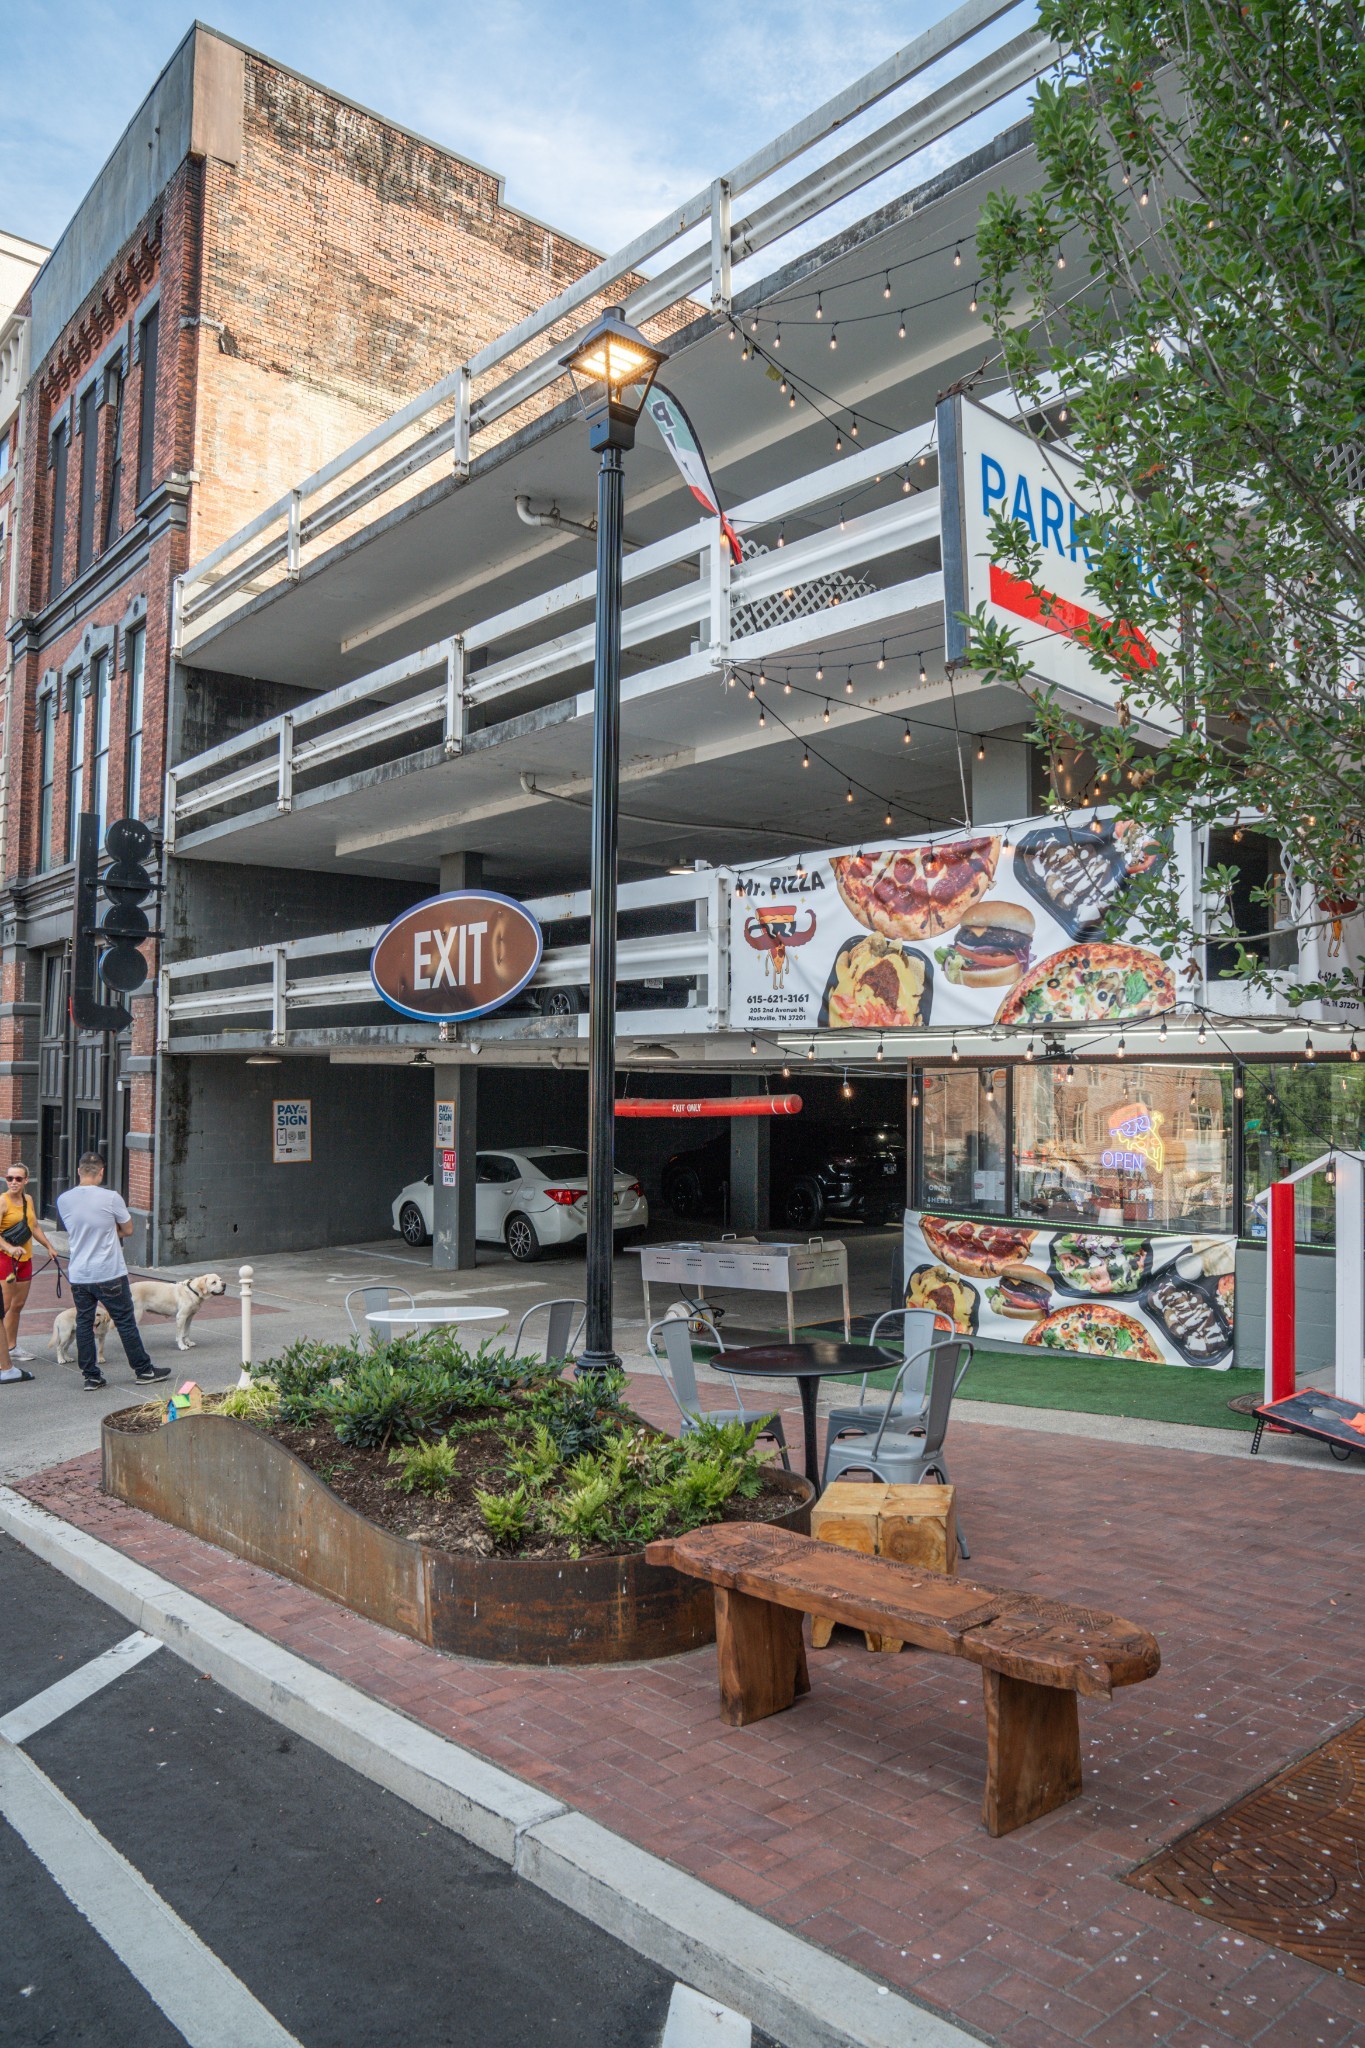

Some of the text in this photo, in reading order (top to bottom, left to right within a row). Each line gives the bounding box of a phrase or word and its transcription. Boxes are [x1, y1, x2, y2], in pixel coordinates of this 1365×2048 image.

[736, 871, 825, 897] Mr. PIZZA
[414, 921, 488, 991] EXIT
[747, 994, 809, 1004] 615-621-3161
[1339, 1000, 1359, 1010] 37201
[278, 1105, 299, 1114] PAY
[672, 1104, 684, 1112] EXIT
[278, 1116, 307, 1125] SIGN
[1102, 1150, 1143, 1171] OPEN
[928, 1184, 952, 1192] ORDER
